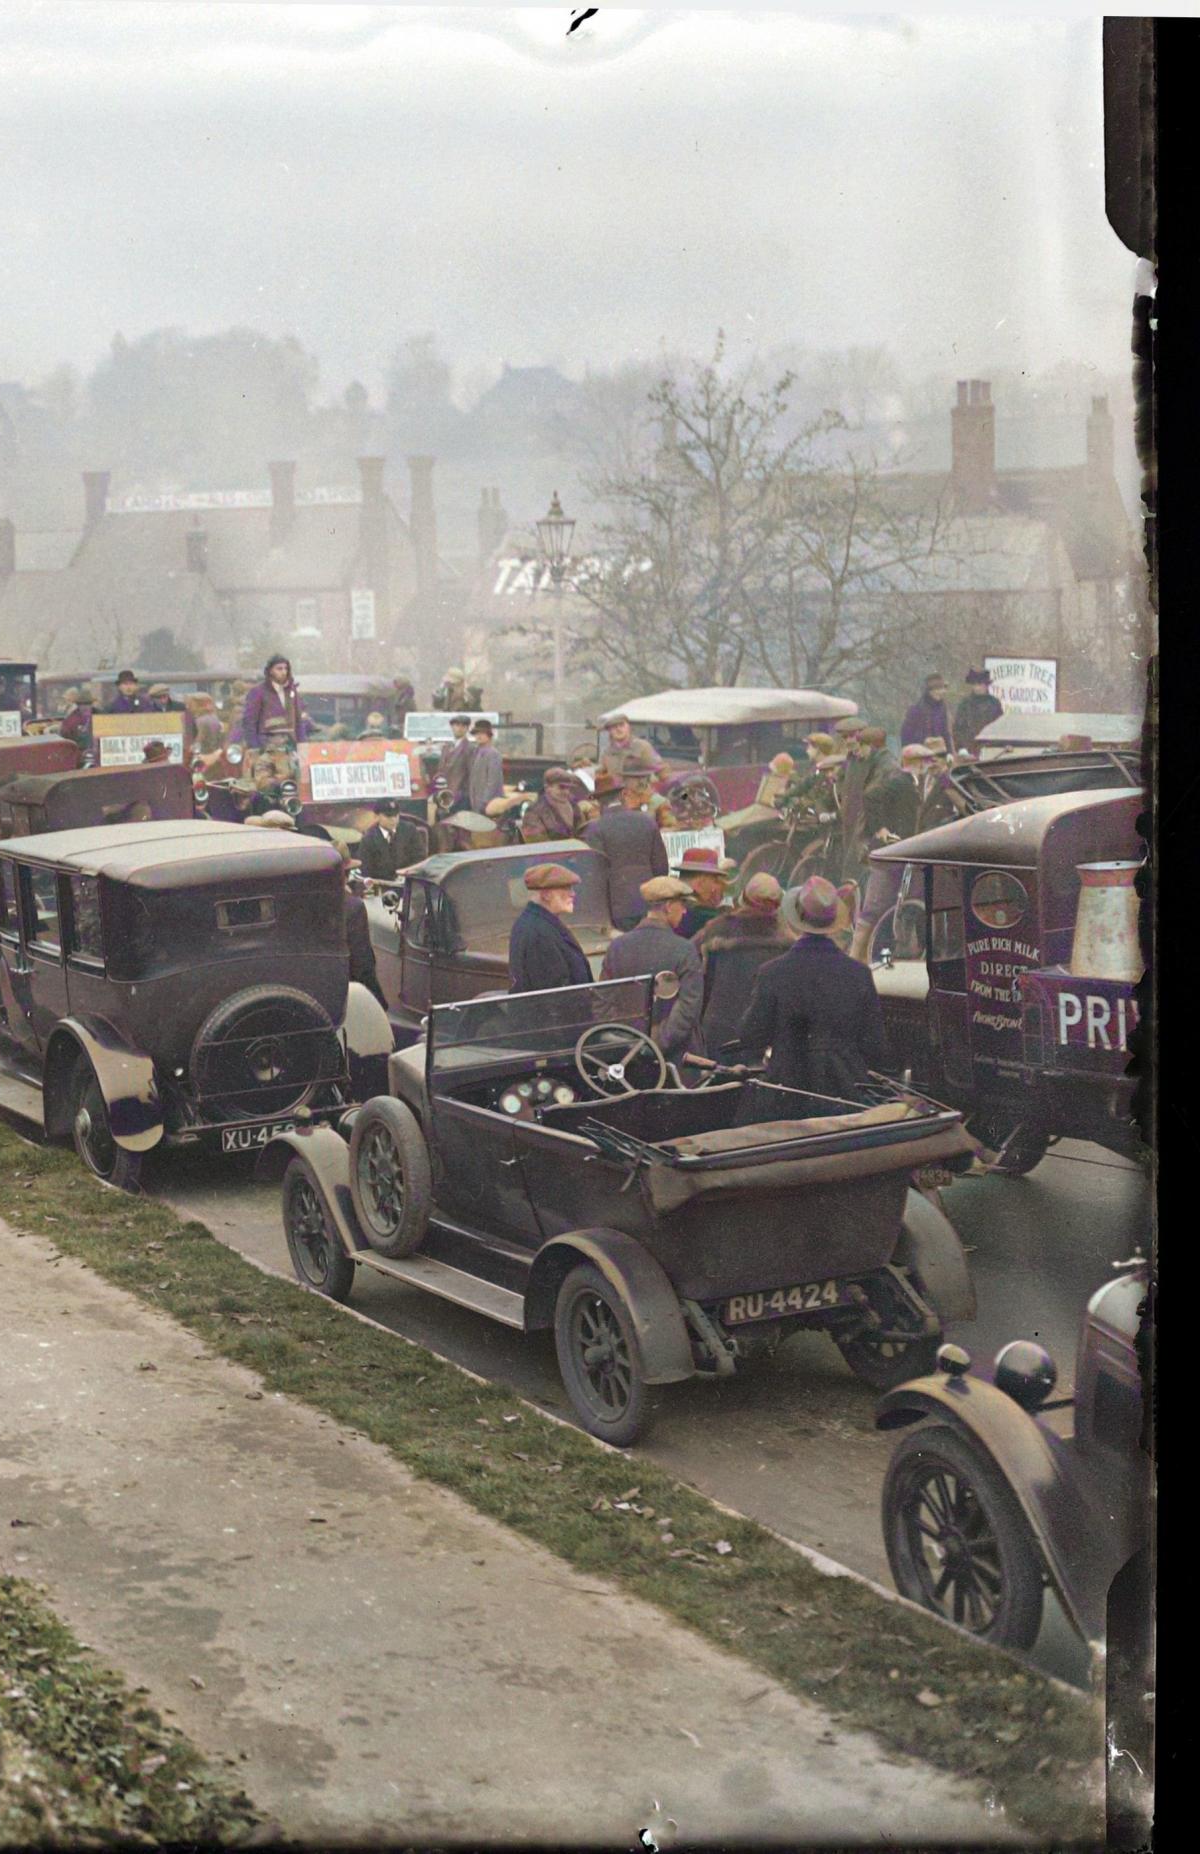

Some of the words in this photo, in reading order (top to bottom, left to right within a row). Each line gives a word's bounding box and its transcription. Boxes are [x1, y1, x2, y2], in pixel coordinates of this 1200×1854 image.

[1029, 663, 1054, 688] TREE
[1008, 687, 1049, 703] GARDENS
[313, 766, 342, 785] DAILY
[346, 764, 385, 784] SKETCH
[391, 772, 406, 790] 19
[967, 938, 990, 956] PURE
[991, 937, 1012, 952] RICH
[1014, 941, 1040, 961] MILK
[980, 961, 1028, 978] DIRECT
[970, 979, 993, 999] FROM
[993, 987, 1011, 1002] THE
